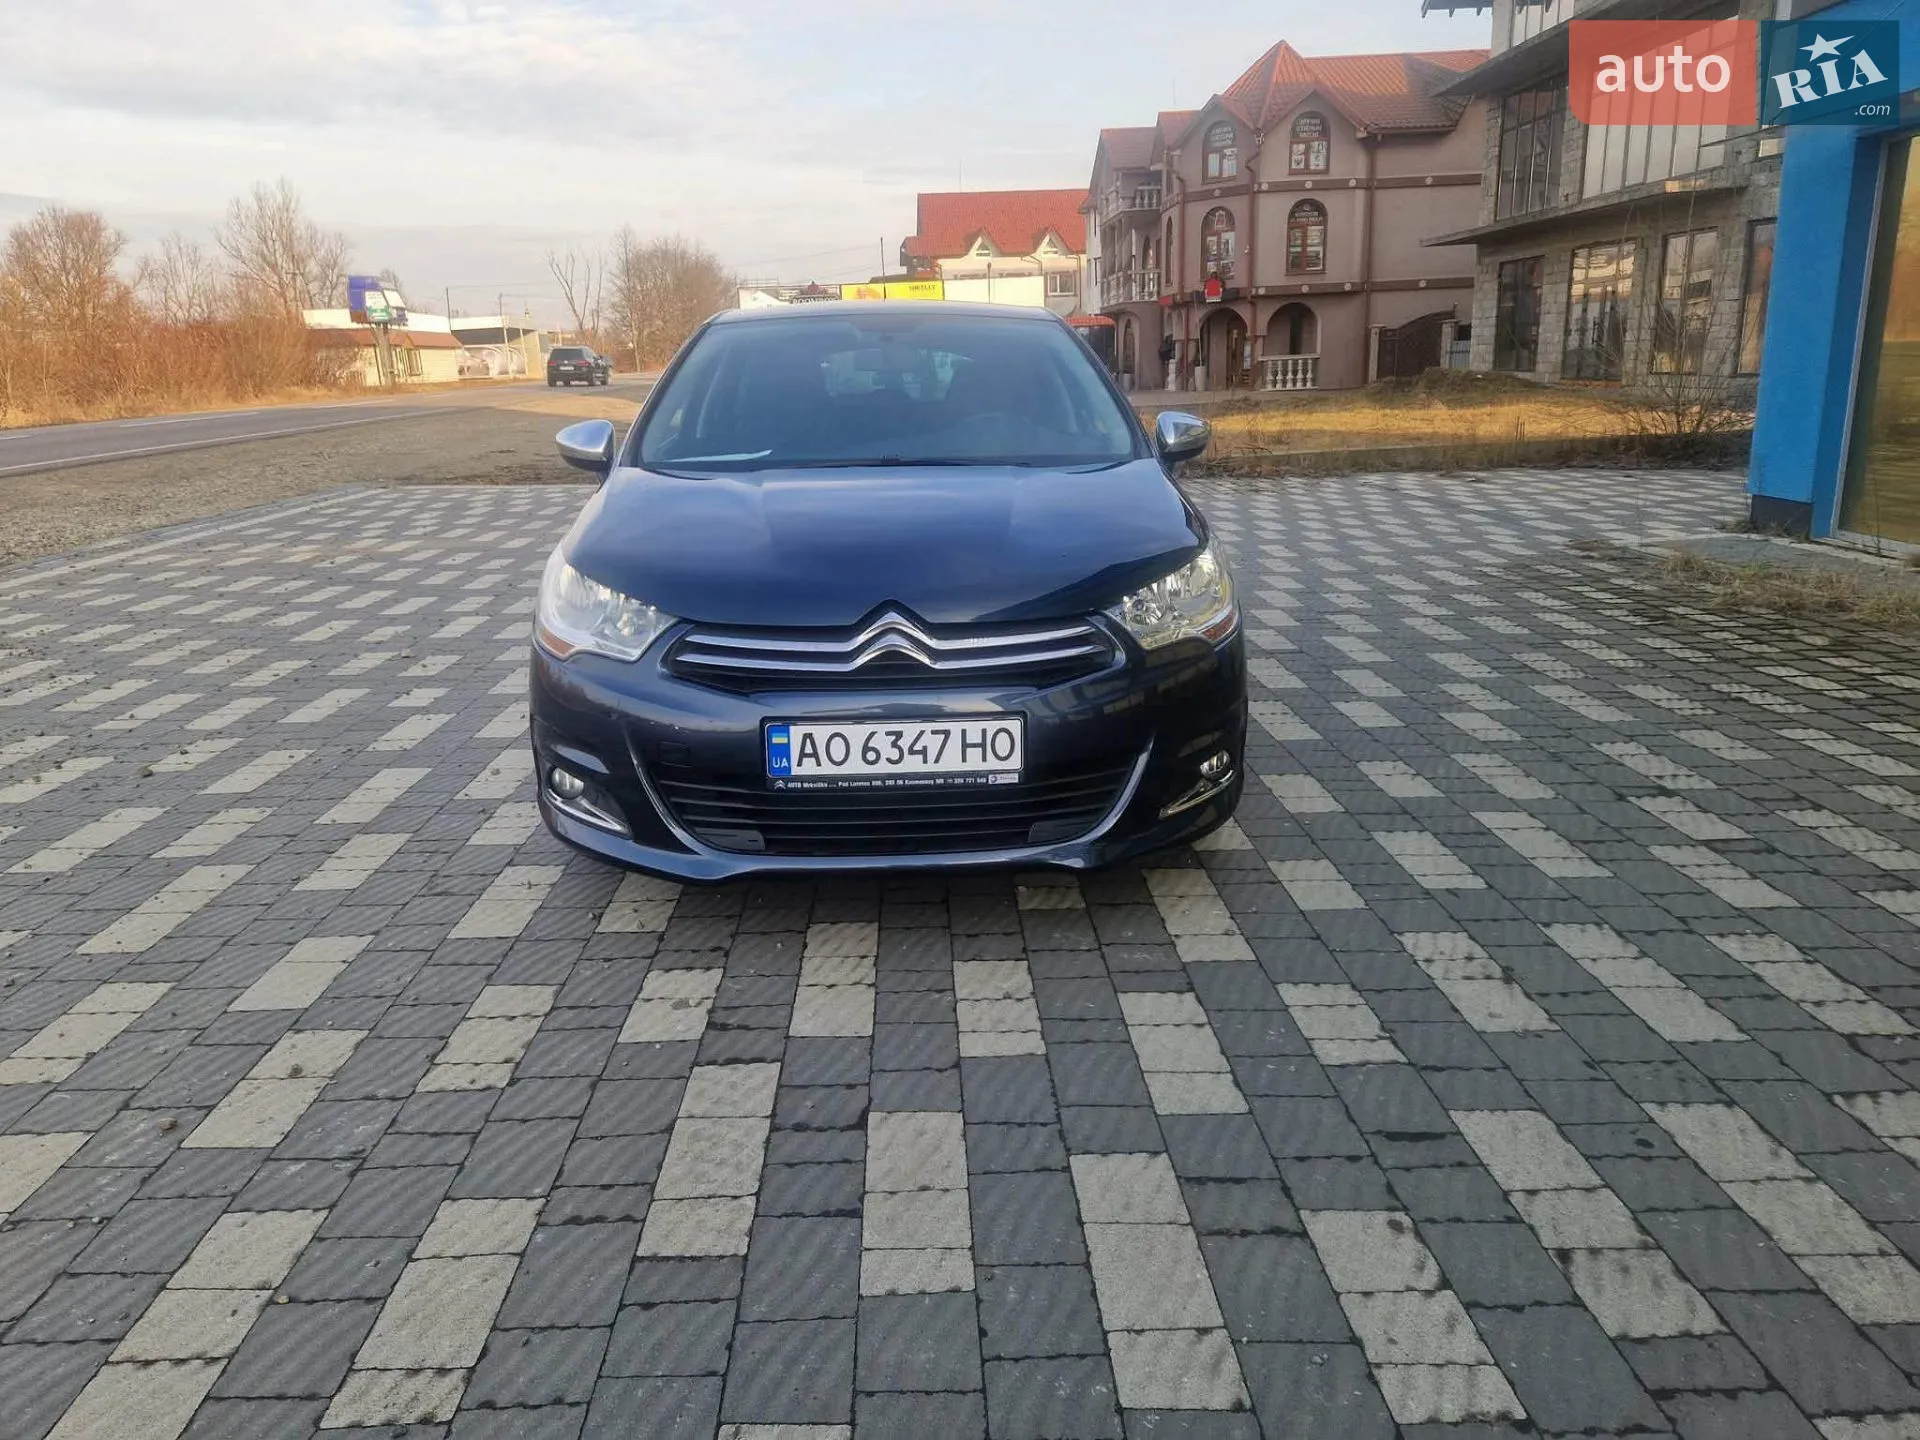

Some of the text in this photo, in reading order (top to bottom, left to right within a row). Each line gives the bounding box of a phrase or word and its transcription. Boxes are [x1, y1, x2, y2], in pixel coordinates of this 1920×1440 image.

[797, 727, 1016, 767] AO 6347 HO
[773, 757, 788, 768] UA
